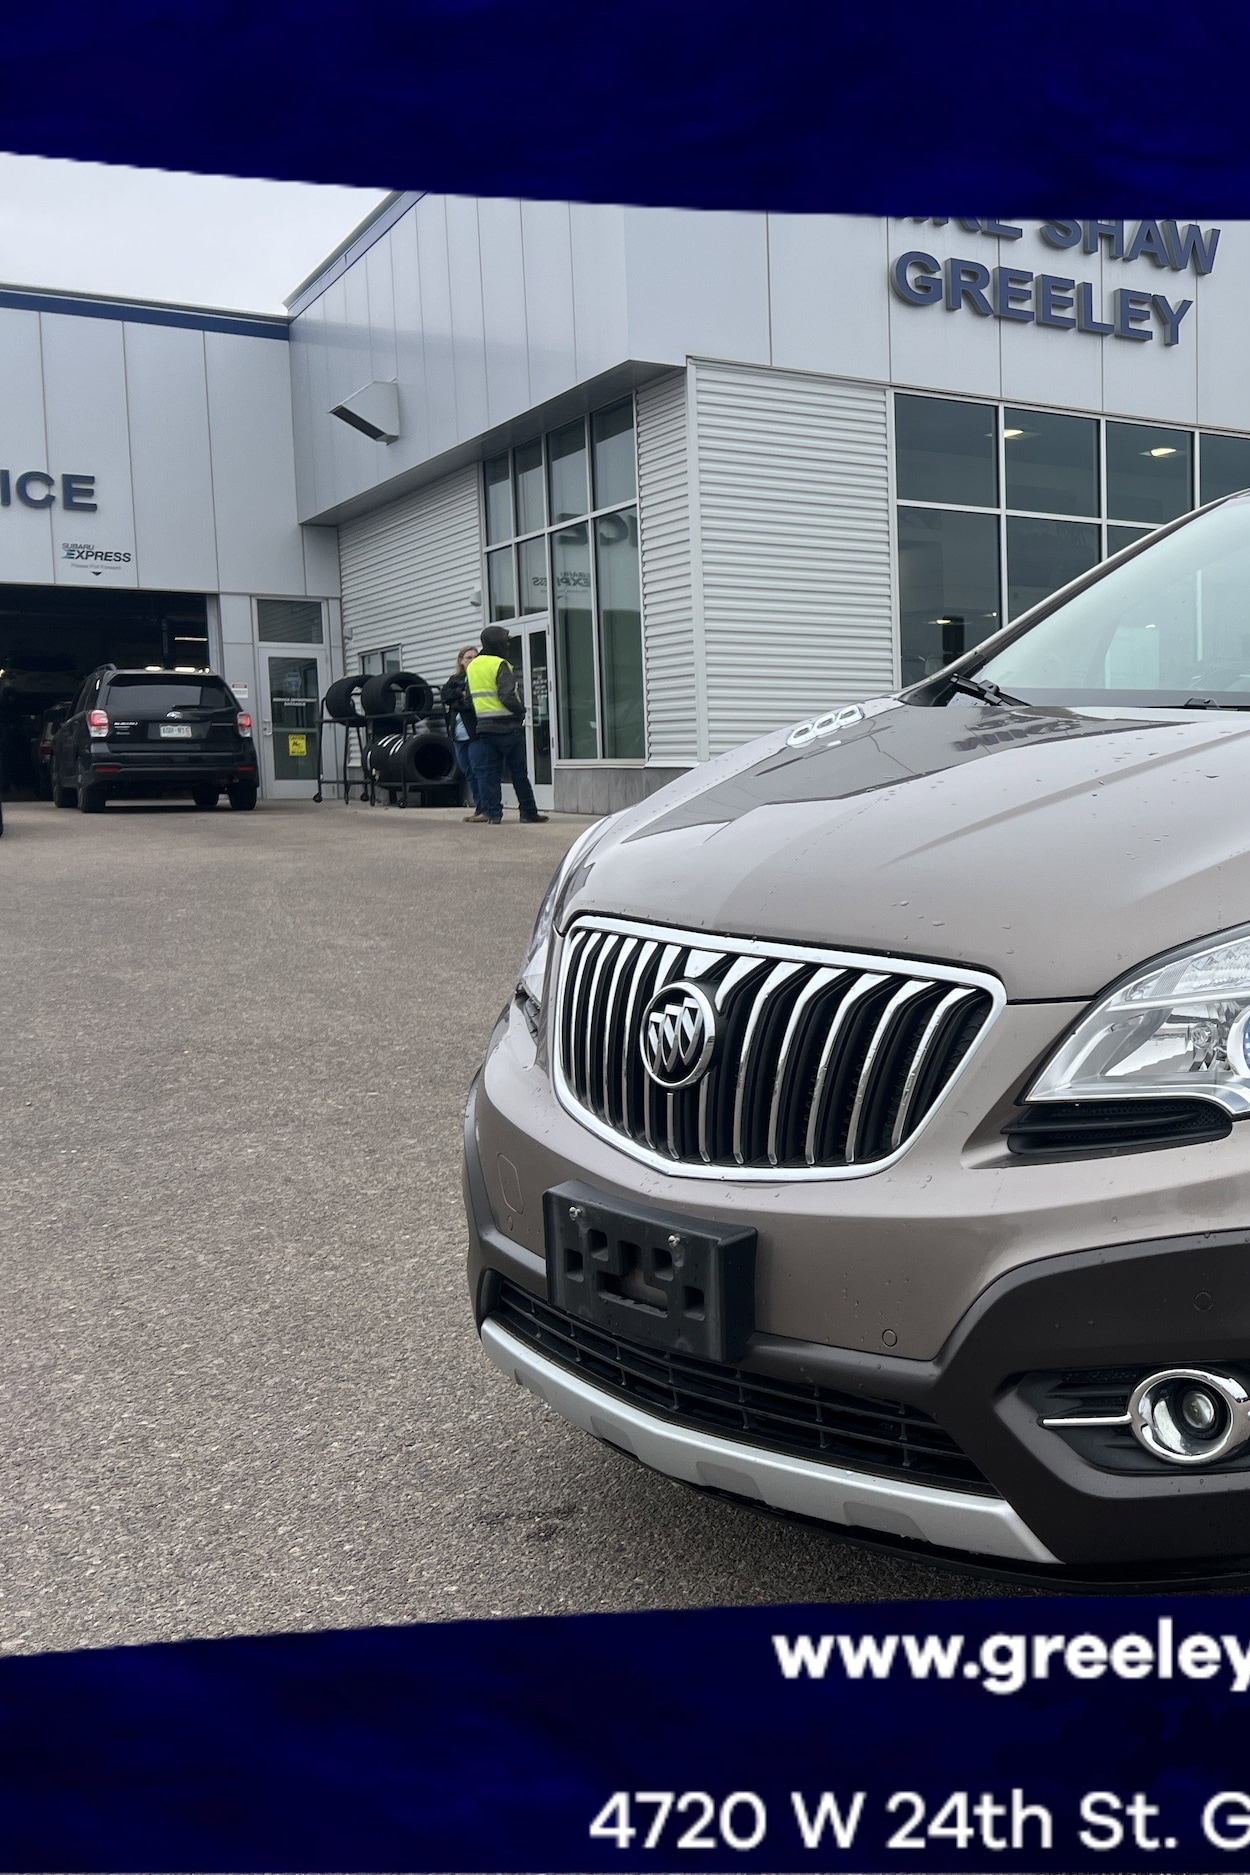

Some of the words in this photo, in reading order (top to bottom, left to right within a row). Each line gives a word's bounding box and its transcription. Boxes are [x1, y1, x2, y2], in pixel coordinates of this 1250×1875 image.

[891, 250, 1193, 346] GREELEY
[61, 542, 95, 551] SUBARU
[61, 549, 132, 563] EXPRESS
